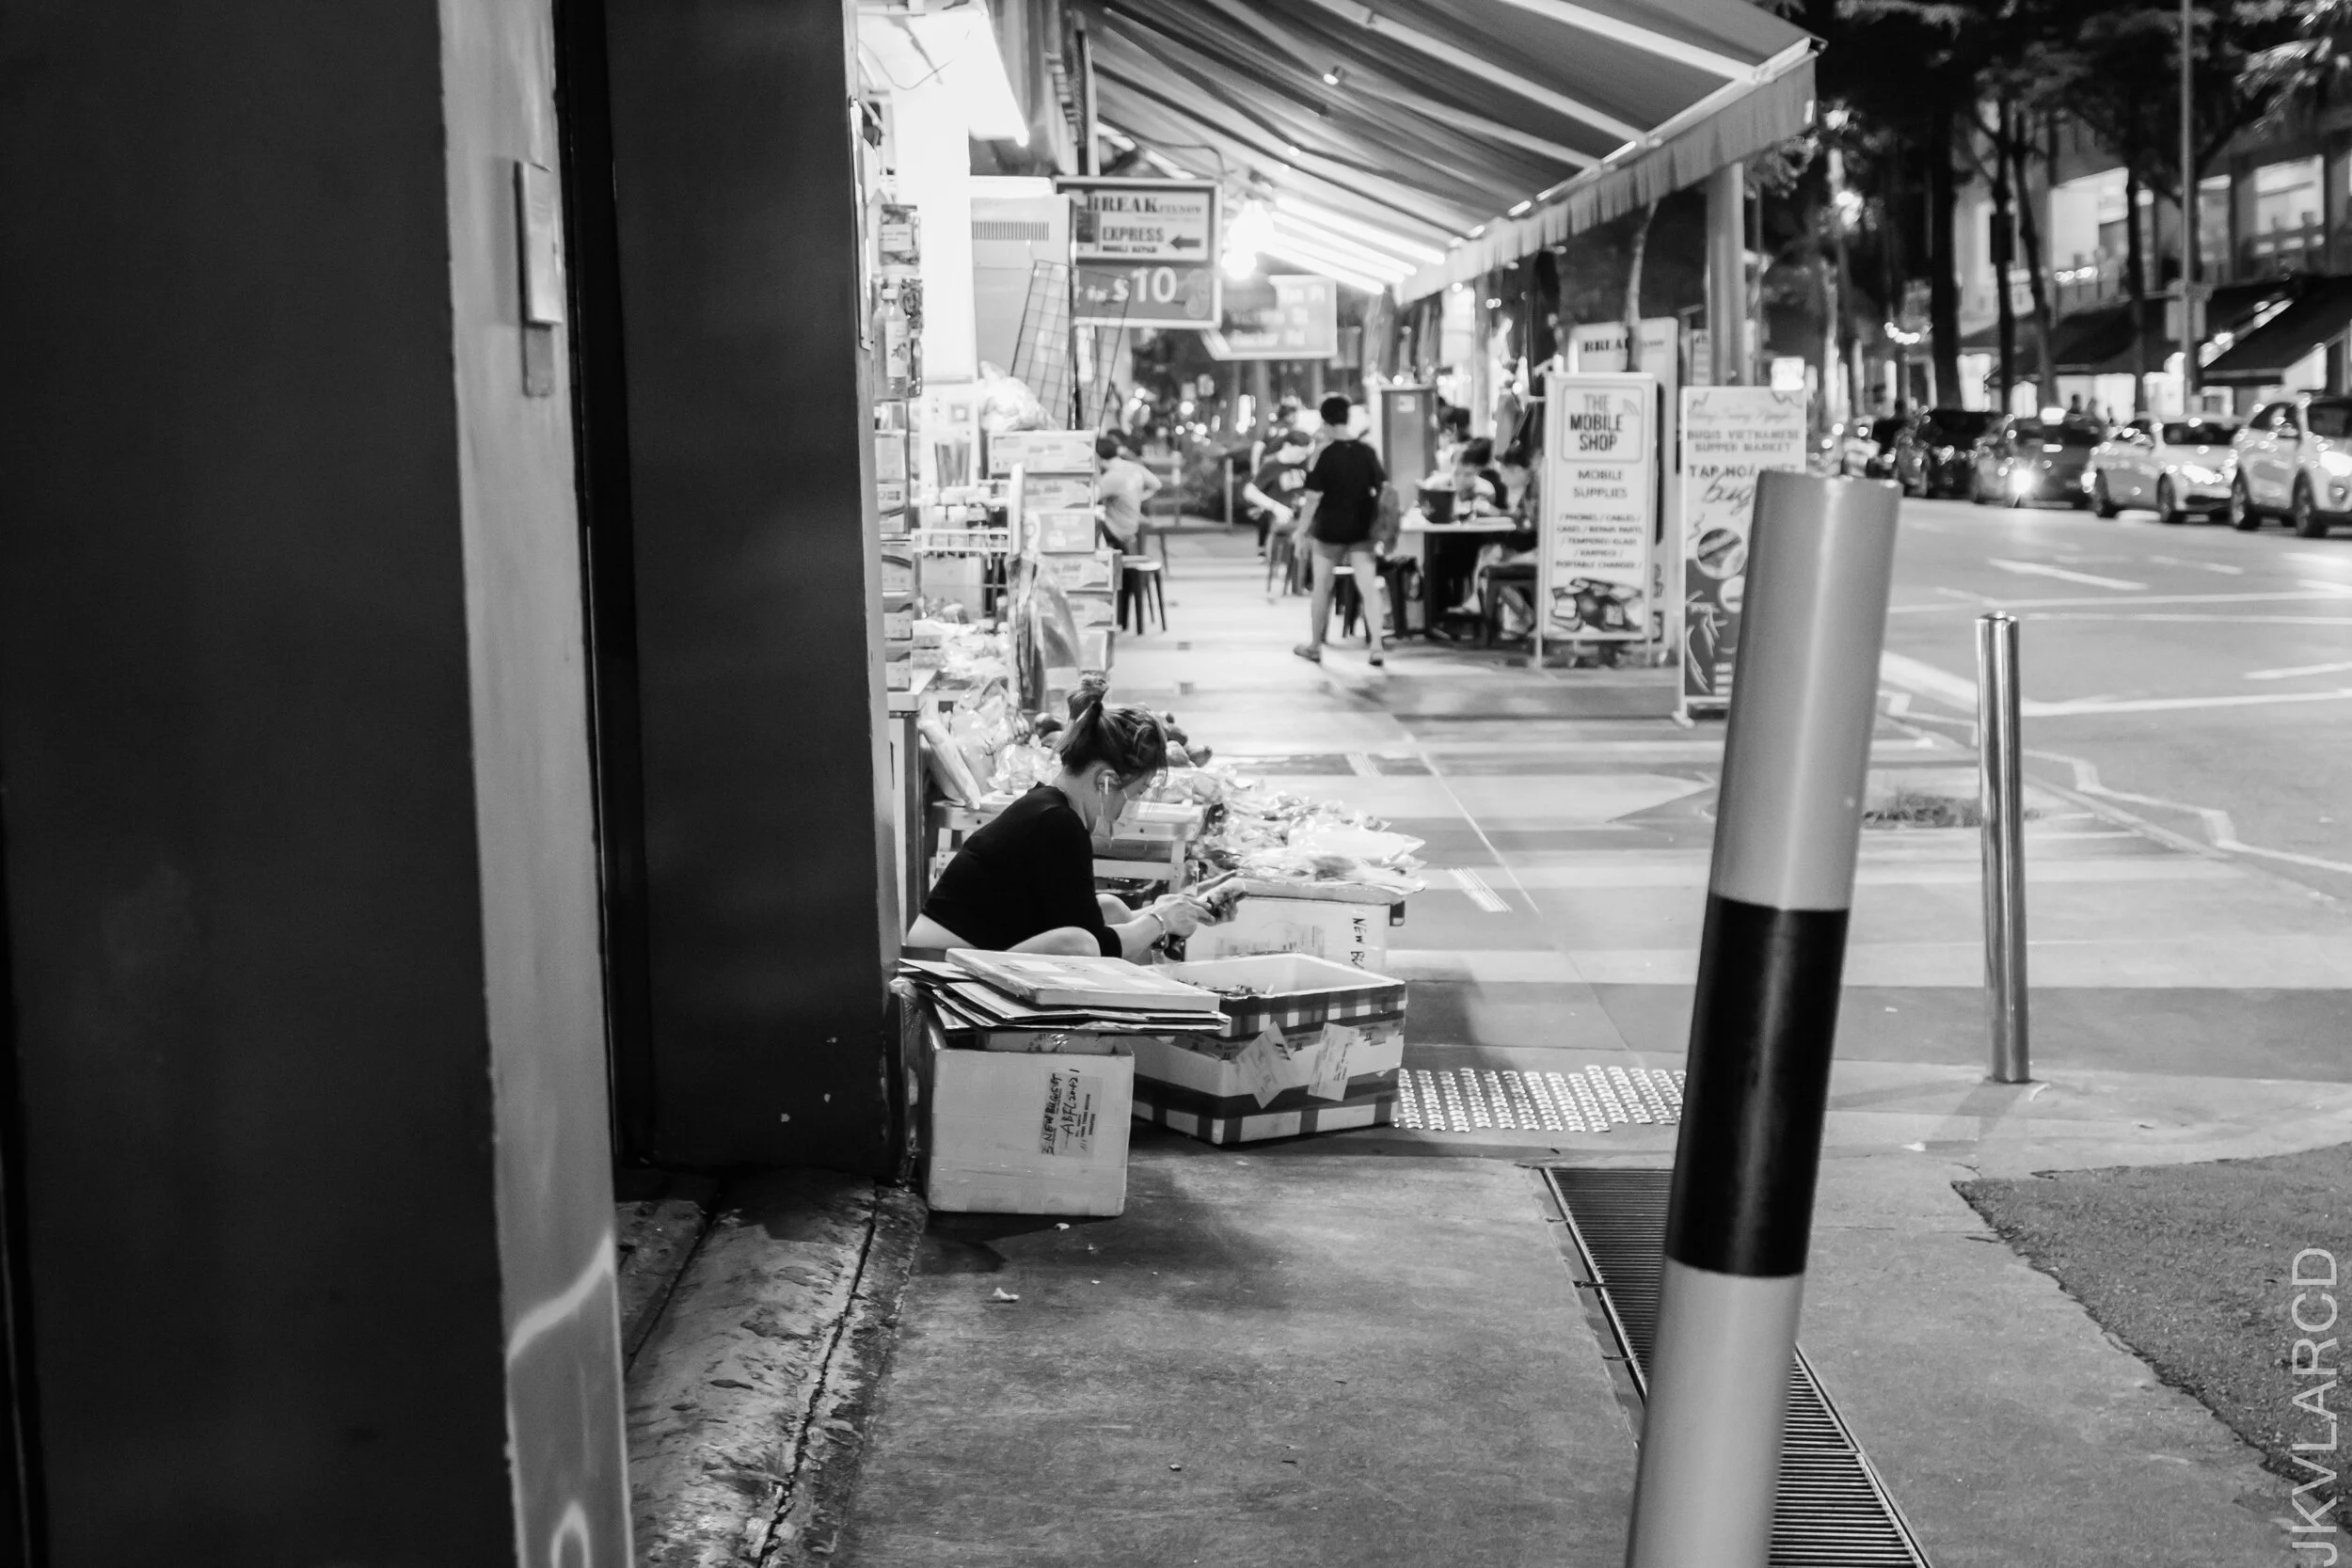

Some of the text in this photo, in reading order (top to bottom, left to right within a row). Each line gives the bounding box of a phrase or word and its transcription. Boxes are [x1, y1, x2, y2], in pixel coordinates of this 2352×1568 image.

[1102, 226, 1165, 243] EXPRESS
[1584, 338, 1628, 353] BREA
[1583, 393, 1611, 413] THE
[1569, 414, 1624, 432] MOBILE
[1580, 434, 1618, 451] SHOP
[1727, 429, 1800, 440] VIETNAMESE
[1578, 469, 1623, 481] MOBILE
[1573, 487, 1629, 499] SUPPLIES
[1353, 918, 1367, 944] NEW
